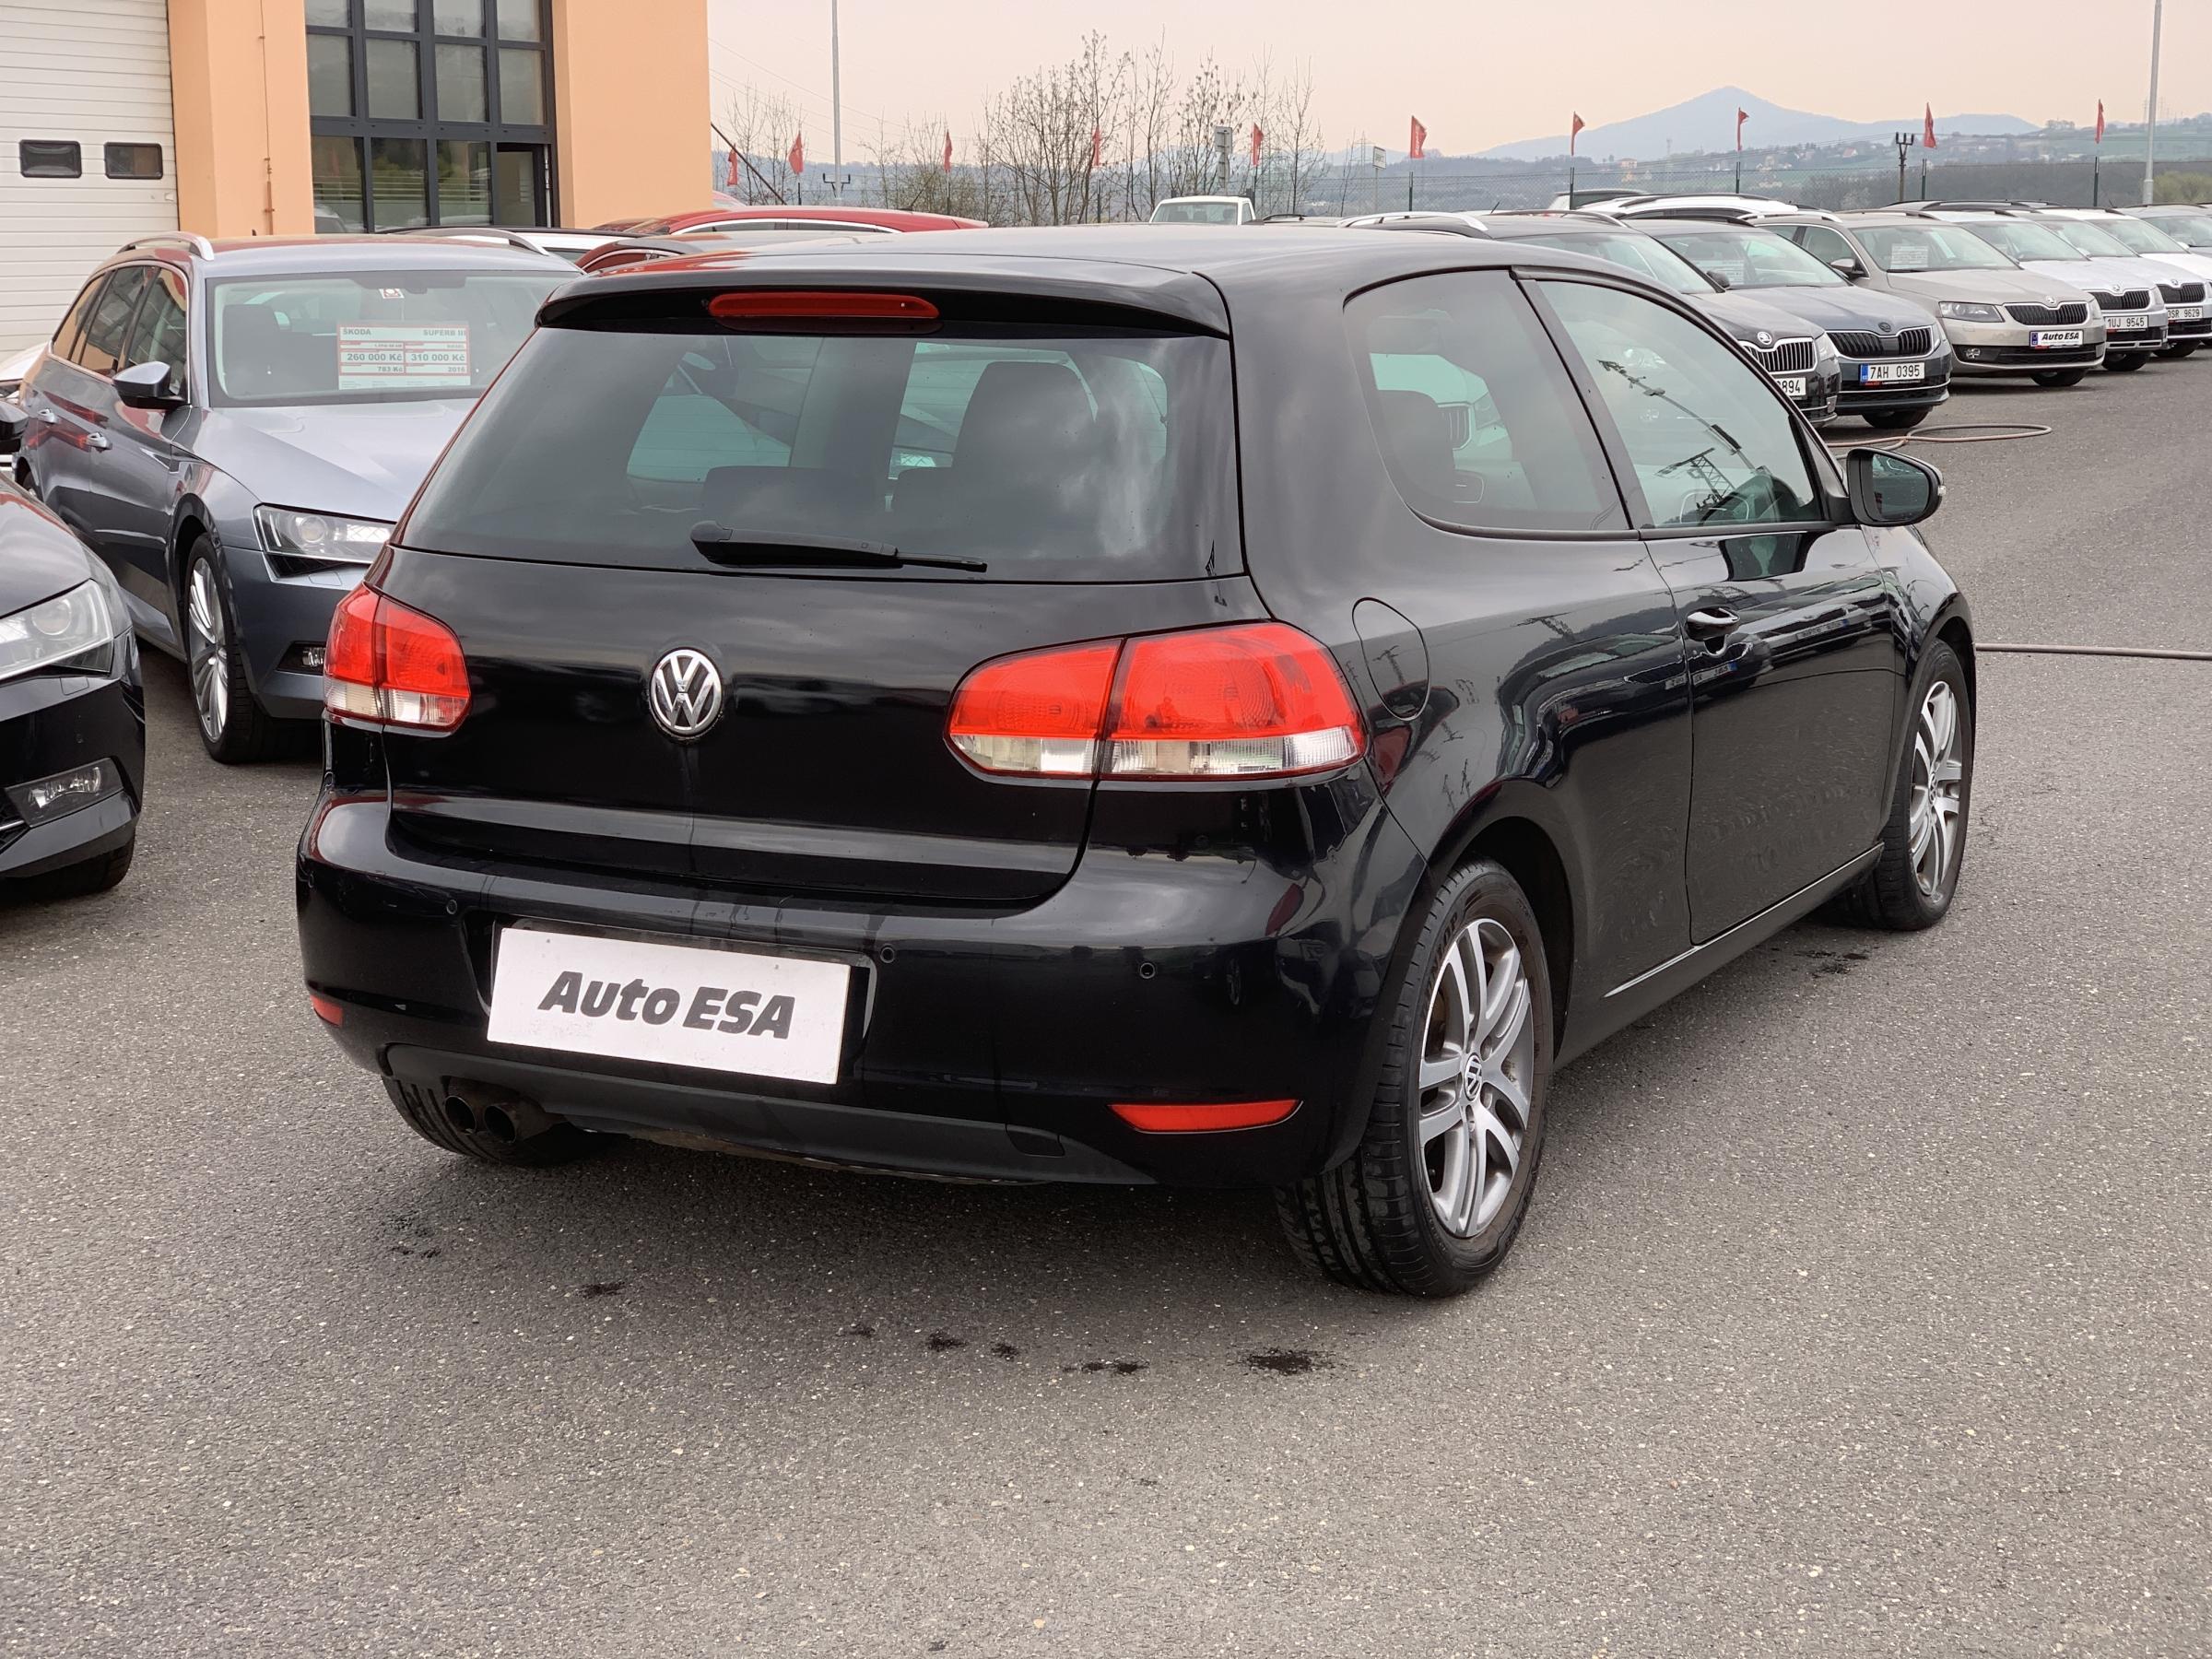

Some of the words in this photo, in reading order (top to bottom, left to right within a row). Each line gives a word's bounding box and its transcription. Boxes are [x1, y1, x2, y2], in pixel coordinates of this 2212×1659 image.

[2184, 309, 2200, 318] 9629
[2107, 318, 2121, 328] 1UJ
[2126, 317, 2145, 327] 9545
[2065, 332, 2079, 340] ESA
[347, 353, 366, 361] 260
[368, 353, 386, 361] 000
[389, 353, 403, 361] Kč
[411, 353, 429, 361] 310
[1870, 366, 1889, 380] 7AH
[1896, 364, 1920, 378] 0395
[537, 971, 680, 1026] Auto
[683, 986, 795, 1040] ESA
